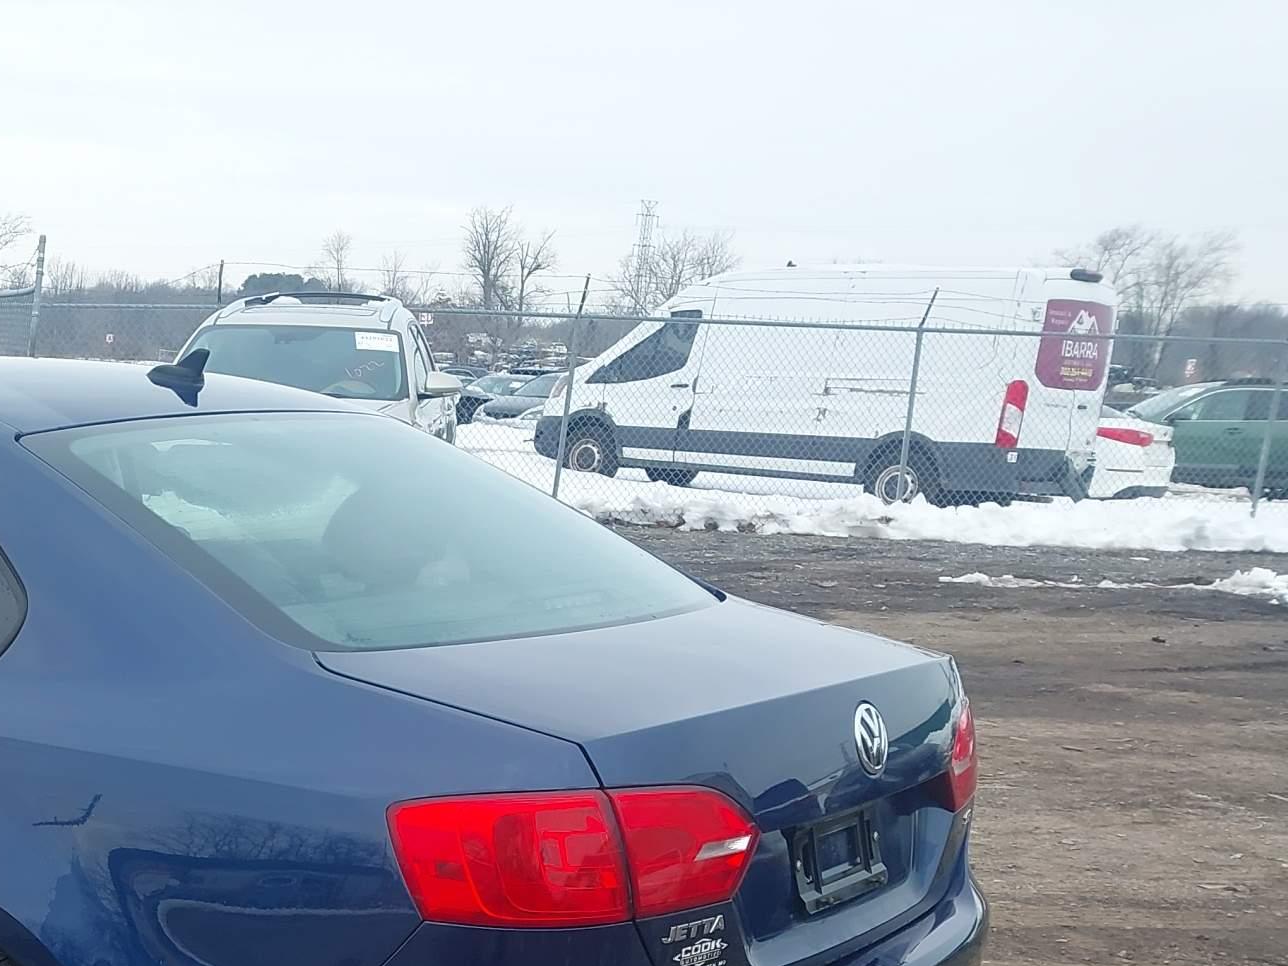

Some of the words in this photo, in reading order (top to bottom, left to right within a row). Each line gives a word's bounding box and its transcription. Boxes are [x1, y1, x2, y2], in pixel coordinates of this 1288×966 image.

[1061, 339, 1098, 360] IBARRA
[661, 914, 725, 944] JETTA
[681, 938, 722, 958] COOK
